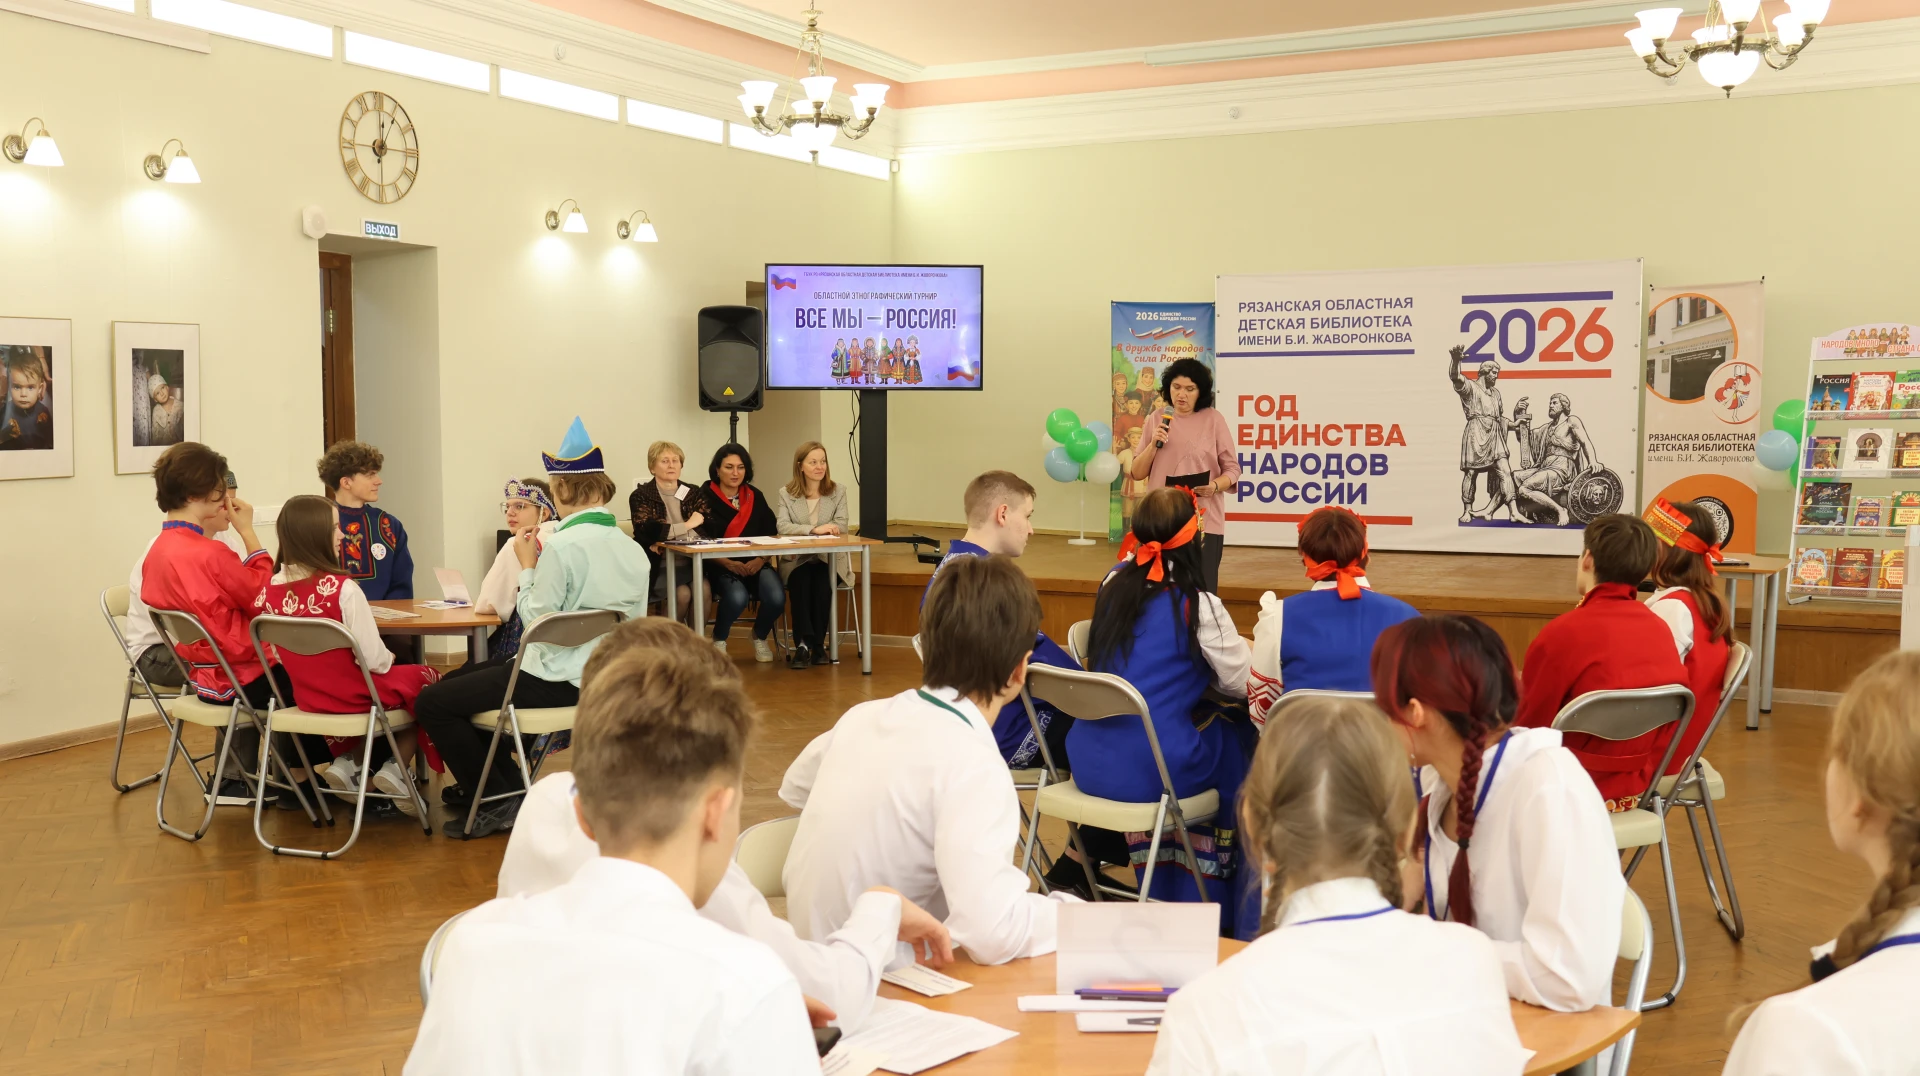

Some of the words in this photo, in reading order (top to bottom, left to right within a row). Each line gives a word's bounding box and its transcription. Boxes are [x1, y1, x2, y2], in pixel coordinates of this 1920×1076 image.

[365, 223, 397, 237] ВЫХОД
[813, 291, 850, 300] ОБЛАСТНОЙ
[852, 290, 912, 300] ЭТНОГРАФИЧЕСКИЙ
[913, 292, 938, 300] ТУРНИР
[1238, 300, 1321, 313] РЯЗАНСКАЯ
[1325, 297, 1413, 311] ОБЛАСТНАЯ
[795, 308, 827, 329] ВСЕ
[832, 308, 863, 329] МЫ
[886, 308, 956, 329] РОССИЯ!
[1135, 311, 1159, 321] 2026
[1238, 318, 1306, 333] ДЕТСКАЯ
[1310, 315, 1412, 330] БИБЛИОТЕКА
[1238, 335, 1281, 346] ИМЕНИ
[1285, 335, 1309, 345] Б.И.
[1312, 333, 1412, 344] ЖАВОРОНКОВА
[1460, 307, 1614, 363] 2026
[1116, 343, 1123, 352] В
[1126, 342, 1162, 354] дружбе
[1165, 343, 1204, 355] народов
[1821, 340, 1853, 349] НАРОДОВ
[1855, 338, 1880, 347] МНОГО
[1887, 344, 1915, 353] СТРАНА
[1238, 394, 1299, 421] ГОД
[1238, 423, 1407, 450] ЕДИНСТВА
[1648, 433, 1699, 441] РЯЗАНСКАЯ
[1701, 433, 1756, 441] ОБЛАСТНАЯ
[1648, 443, 1689, 453] ДЕТСКАЯ
[1692, 443, 1755, 451] БИБЛИОТЕКА
[1677, 454, 1694, 462] Б.И.
[1238, 453, 1389, 479] НАРОДОВ
[1237, 481, 1368, 505] РОССИИ
